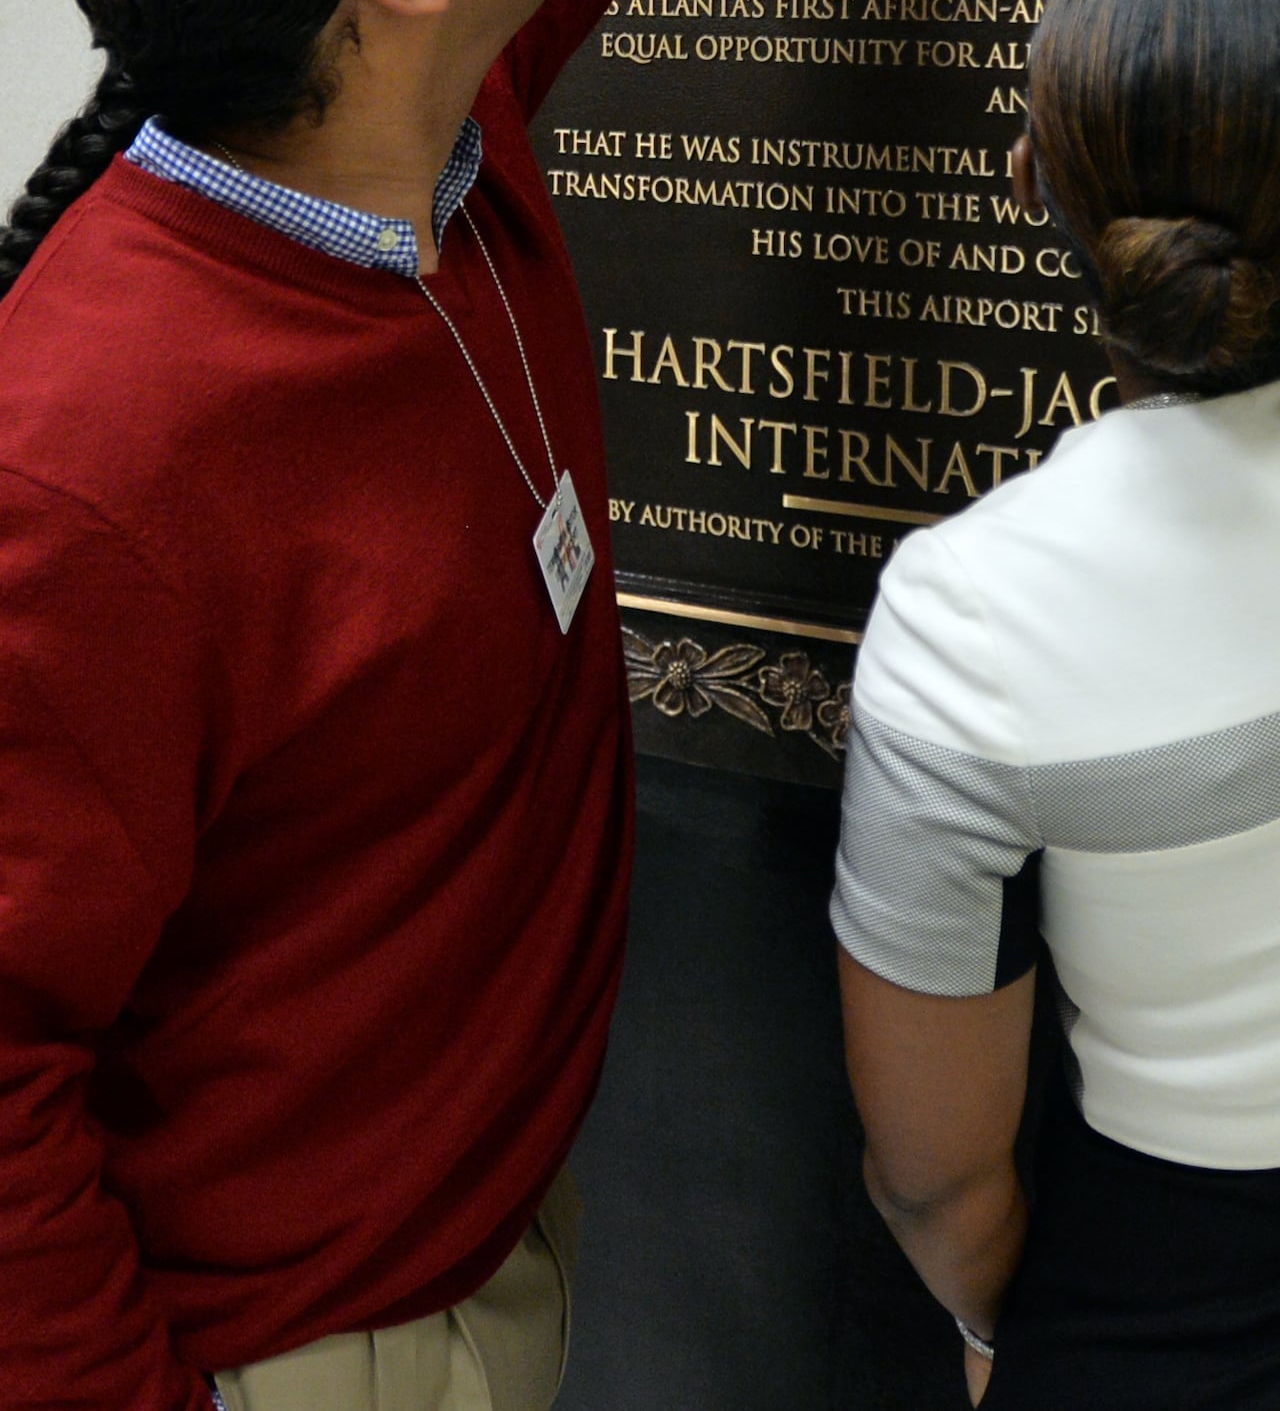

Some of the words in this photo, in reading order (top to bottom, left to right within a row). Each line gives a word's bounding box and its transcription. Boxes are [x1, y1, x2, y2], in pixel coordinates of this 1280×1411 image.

[601, 32, 689, 64] EQUAL
[695, 34, 907, 66] OPPORTUNITY
[917, 40, 981, 68] FOR
[554, 128, 626, 158] THAT
[635, 132, 673, 160] HE
[680, 134, 741, 164] WAS
[751, 137, 995, 178] INSTRUMENTAL
[548, 169, 814, 212] TRANSFORMATION
[826, 187, 907, 218] INTO
[915, 191, 981, 223] THE
[751, 228, 803, 259] HIS
[813, 232, 889, 264] LOVE
[899, 238, 942, 268] OF
[949, 243, 1026, 274] AND
[837, 287, 911, 320] THIS
[920, 294, 1063, 333] AIRPORT
[602, 327, 1118, 439] HARTSFIELD-JAC
[608, 497, 636, 523] BY
[639, 500, 785, 545] AUTHORITY
[790, 523, 824, 550] OF
[831, 528, 883, 560] THE
